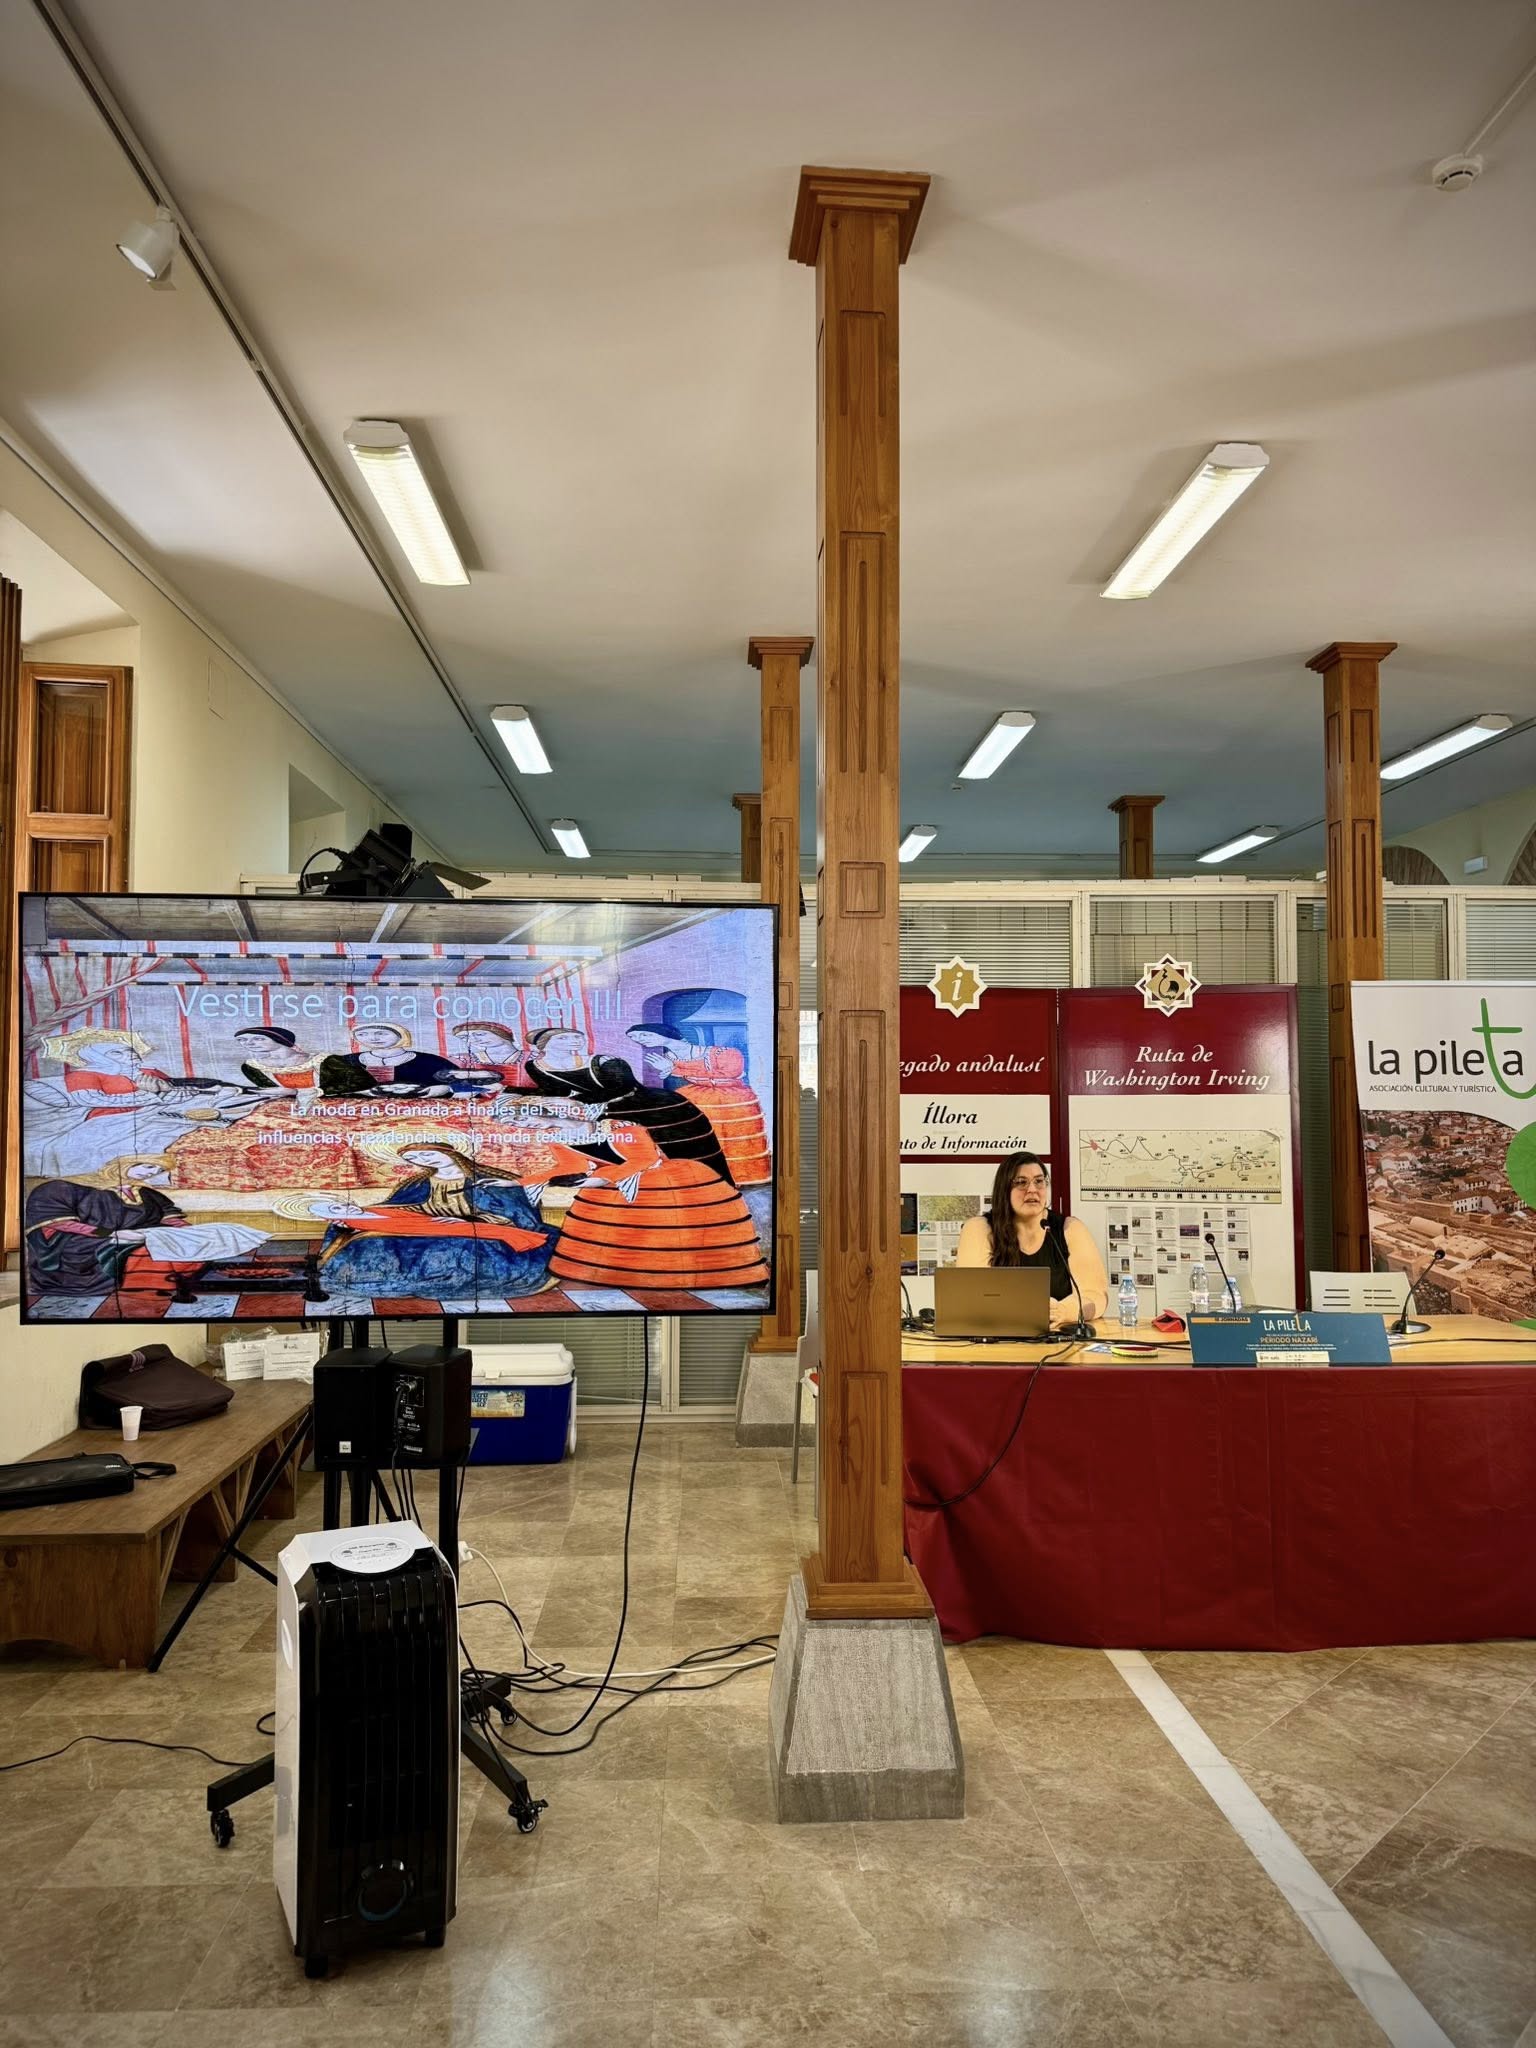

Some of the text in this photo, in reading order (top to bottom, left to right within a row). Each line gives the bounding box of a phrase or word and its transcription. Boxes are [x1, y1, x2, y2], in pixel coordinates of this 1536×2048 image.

[174, 985, 621, 1025] Vestirse para conocer III
[1135, 1044, 1213, 1063] Ruta de
[1368, 998, 1536, 1100] la pileta
[956, 1053, 1045, 1073] andalusí
[1084, 1068, 1270, 1091] Washington Irving
[1369, 1084, 1497, 1093] ASOCIACIÓN CULTURAL Y TURÍSTICA
[290, 1103, 307, 1116] La
[312, 1103, 356, 1116] moda
[361, 1106, 382, 1116] en
[385, 1103, 449, 1116] Granada
[454, 1107, 463, 1116] a
[467, 1103, 515, 1116] finales
[520, 1103, 543, 1116] del
[549, 1103, 580, 1119] siglo
[922, 1101, 978, 1124] Íllora
[258, 1130, 342, 1144] influencias
[346, 1133, 355, 1147] y
[359, 1131, 443, 1144] tendencias
[471, 1130, 483, 1143] la
[488, 1130, 530, 1143] moda
[921, 1135, 937, 1149] de
[940, 1135, 1027, 1153] Información
[1263, 1319, 1275, 1331] LA
